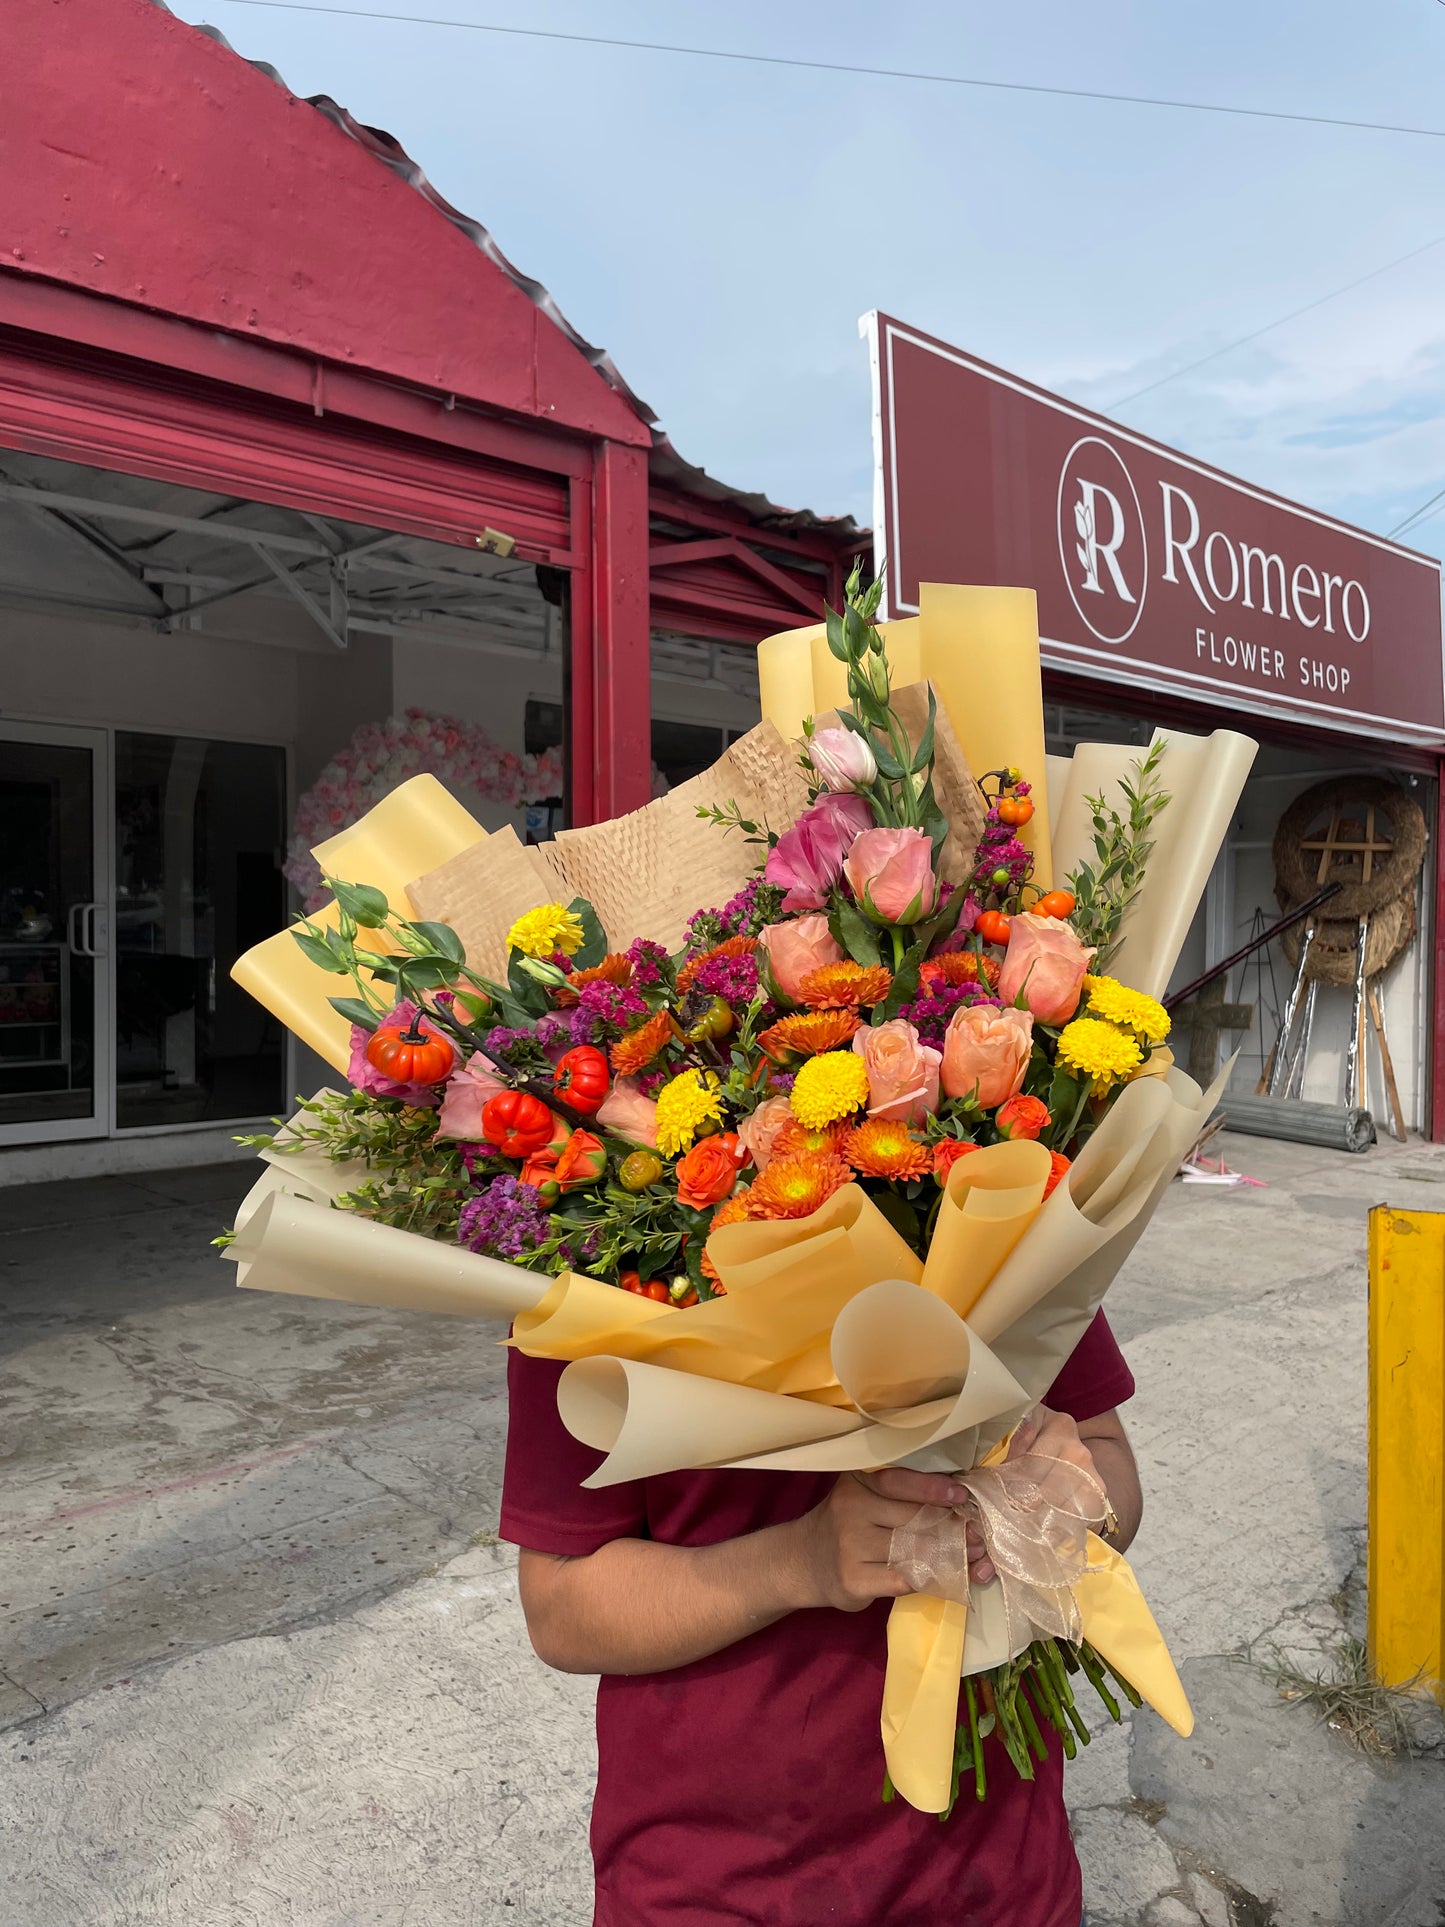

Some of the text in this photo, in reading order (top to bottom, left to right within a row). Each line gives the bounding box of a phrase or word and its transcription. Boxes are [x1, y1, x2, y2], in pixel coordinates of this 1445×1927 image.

[1075, 478, 1136, 604] R
[1159, 480, 1370, 643] Romero
[1195, 628, 1351, 694] FLOWER SHOP
